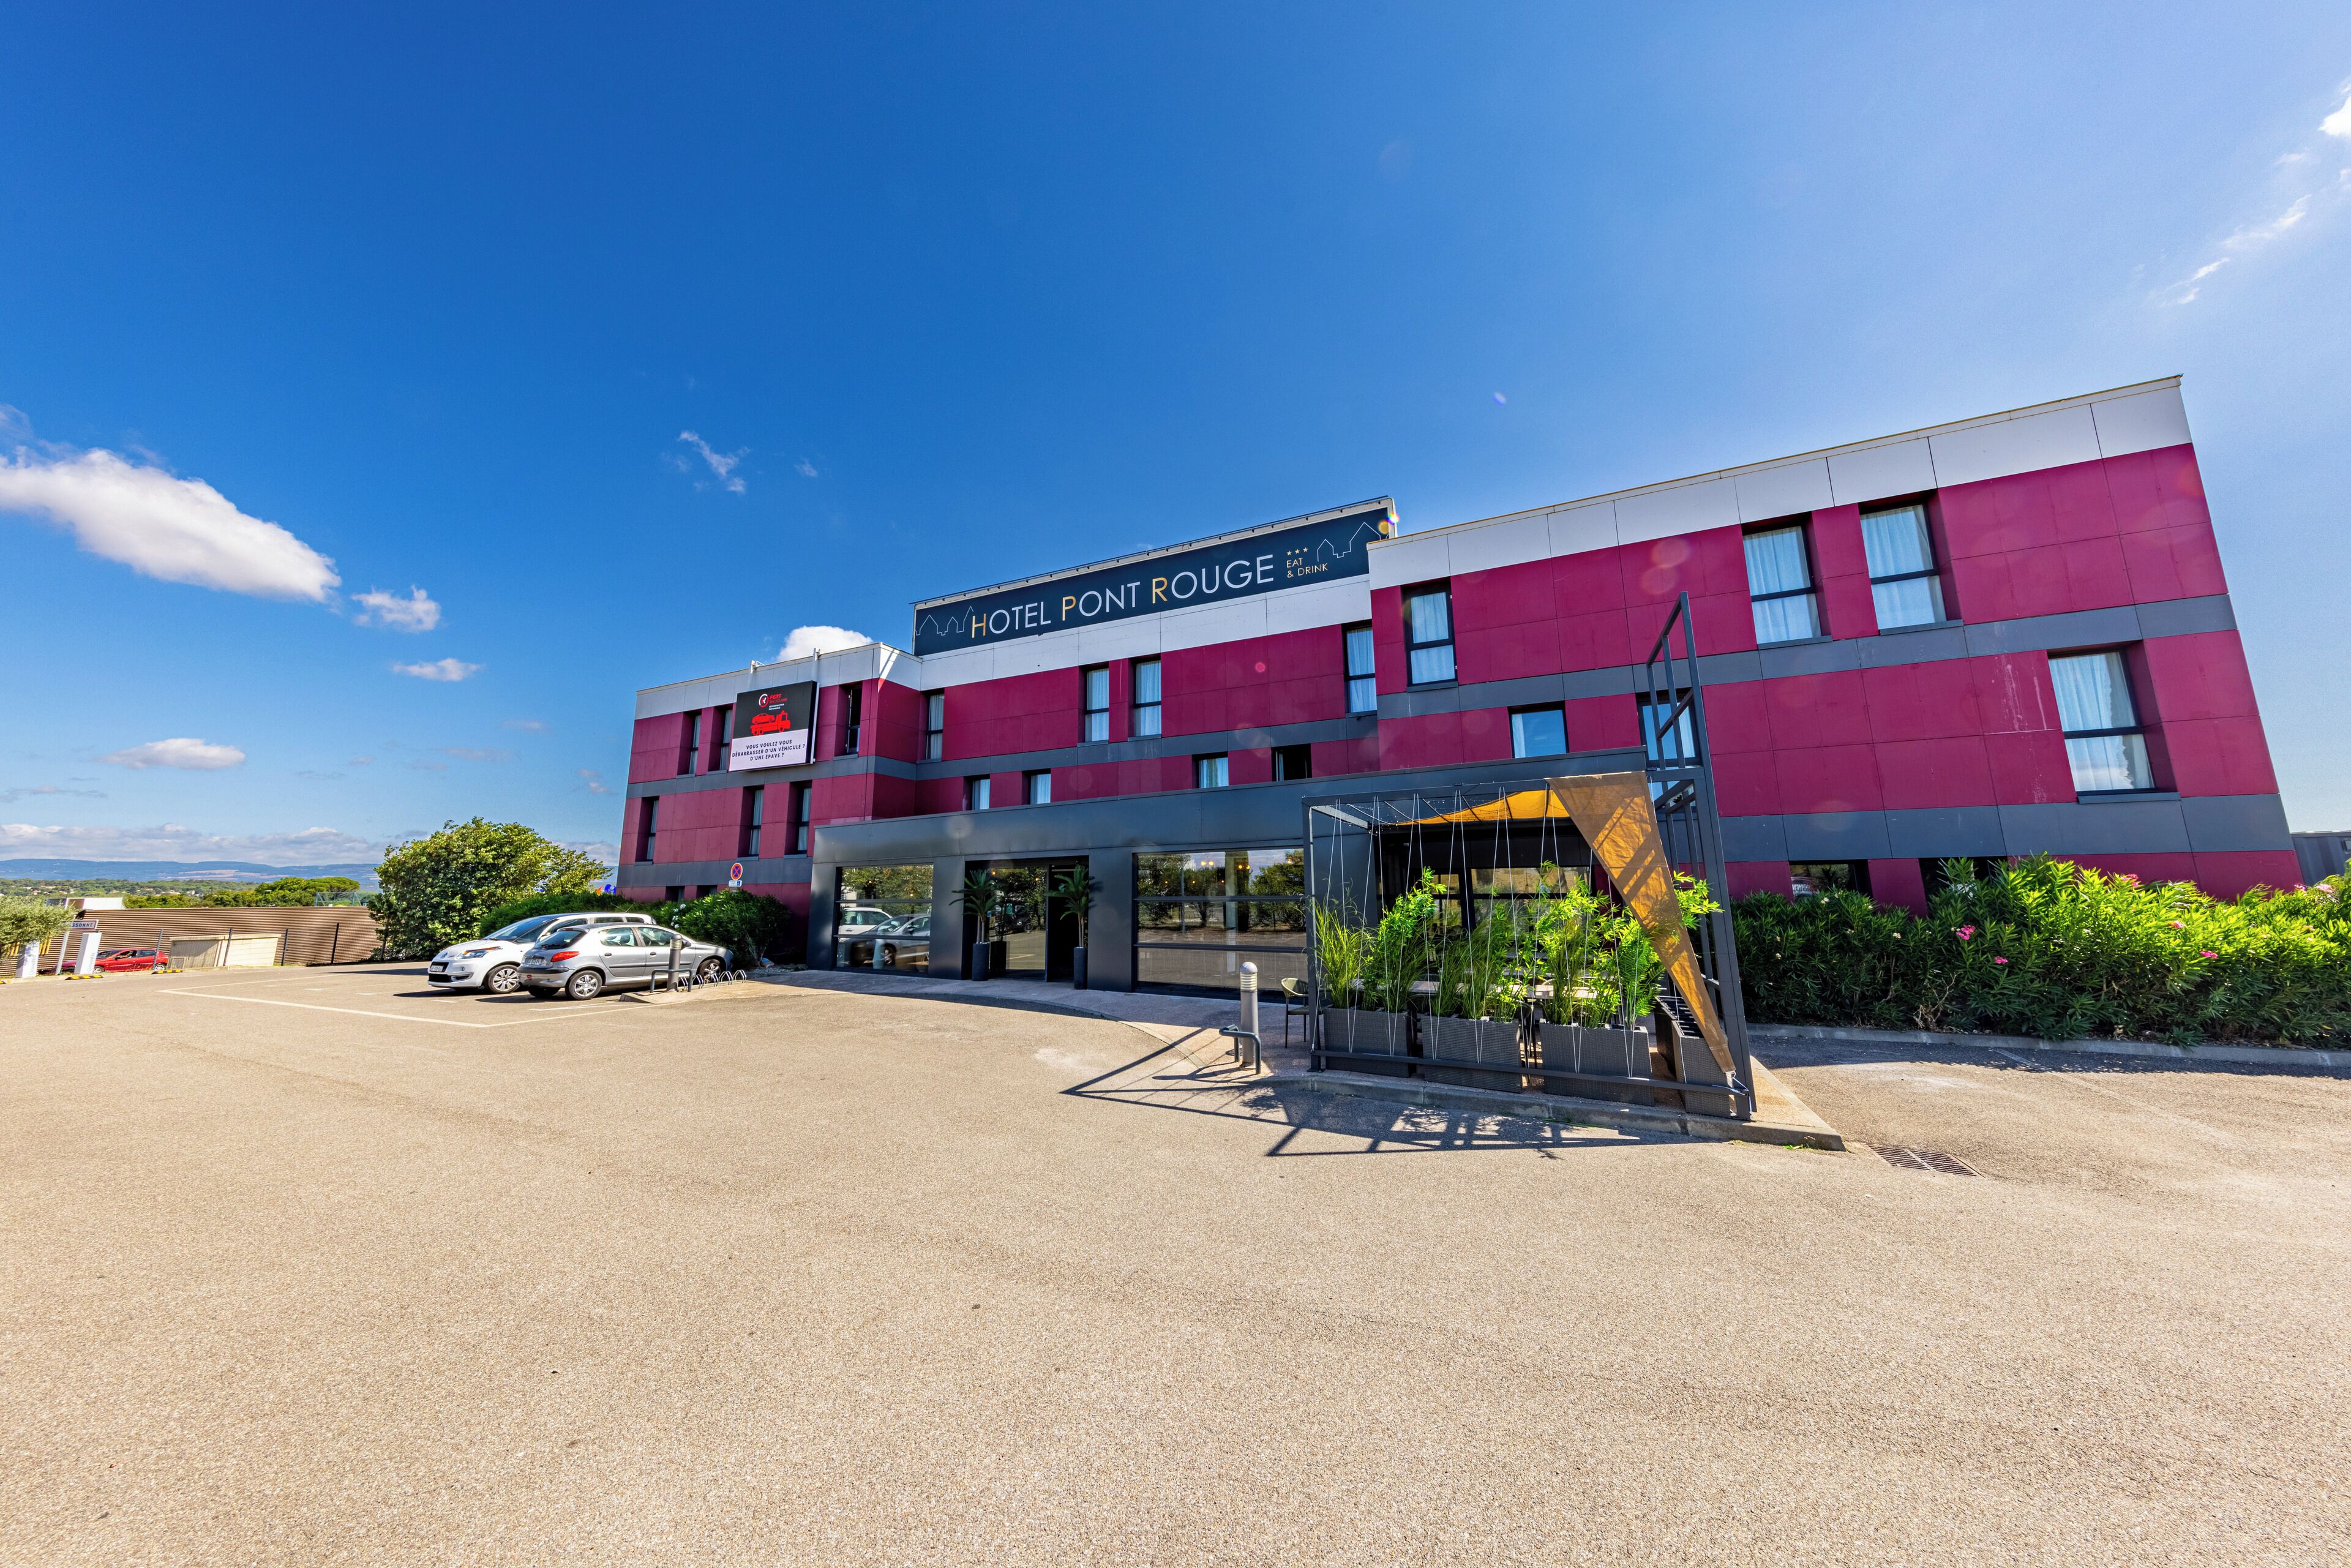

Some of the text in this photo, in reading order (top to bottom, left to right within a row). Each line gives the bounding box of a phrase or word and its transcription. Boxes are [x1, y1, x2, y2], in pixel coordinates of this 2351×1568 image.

[1286, 558, 1303, 568] EAT
[1297, 563, 1328, 576] DRINK
[972, 554, 1274, 638] HOTEL PONT ROUGE
